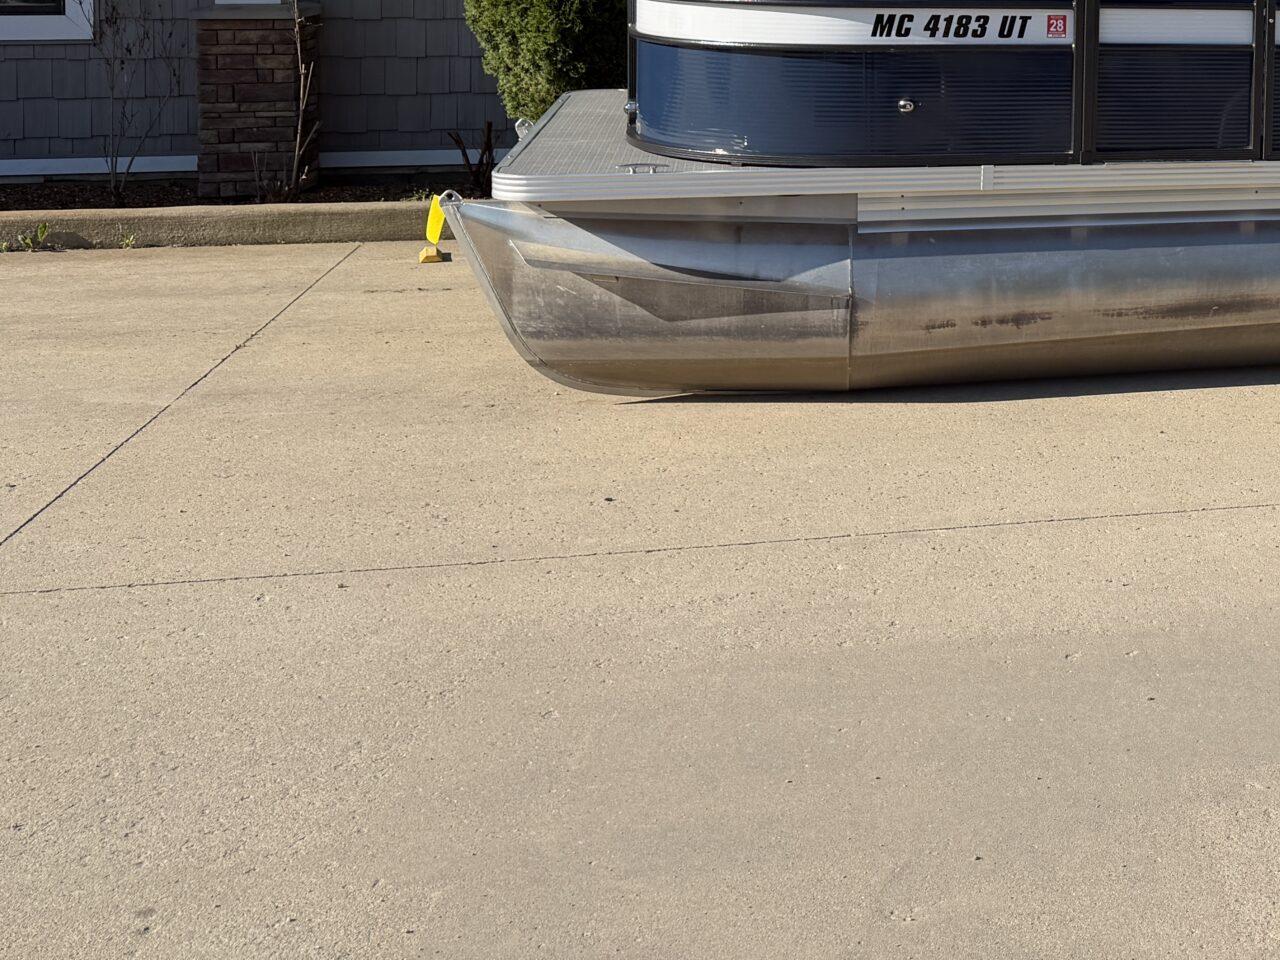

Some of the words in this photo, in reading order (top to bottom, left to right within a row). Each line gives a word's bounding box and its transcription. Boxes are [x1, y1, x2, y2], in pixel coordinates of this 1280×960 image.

[871, 13, 915, 37] MC
[923, 14, 990, 38] 4183
[998, 16, 1032, 38] UT
[1049, 19, 1064, 31] 28
